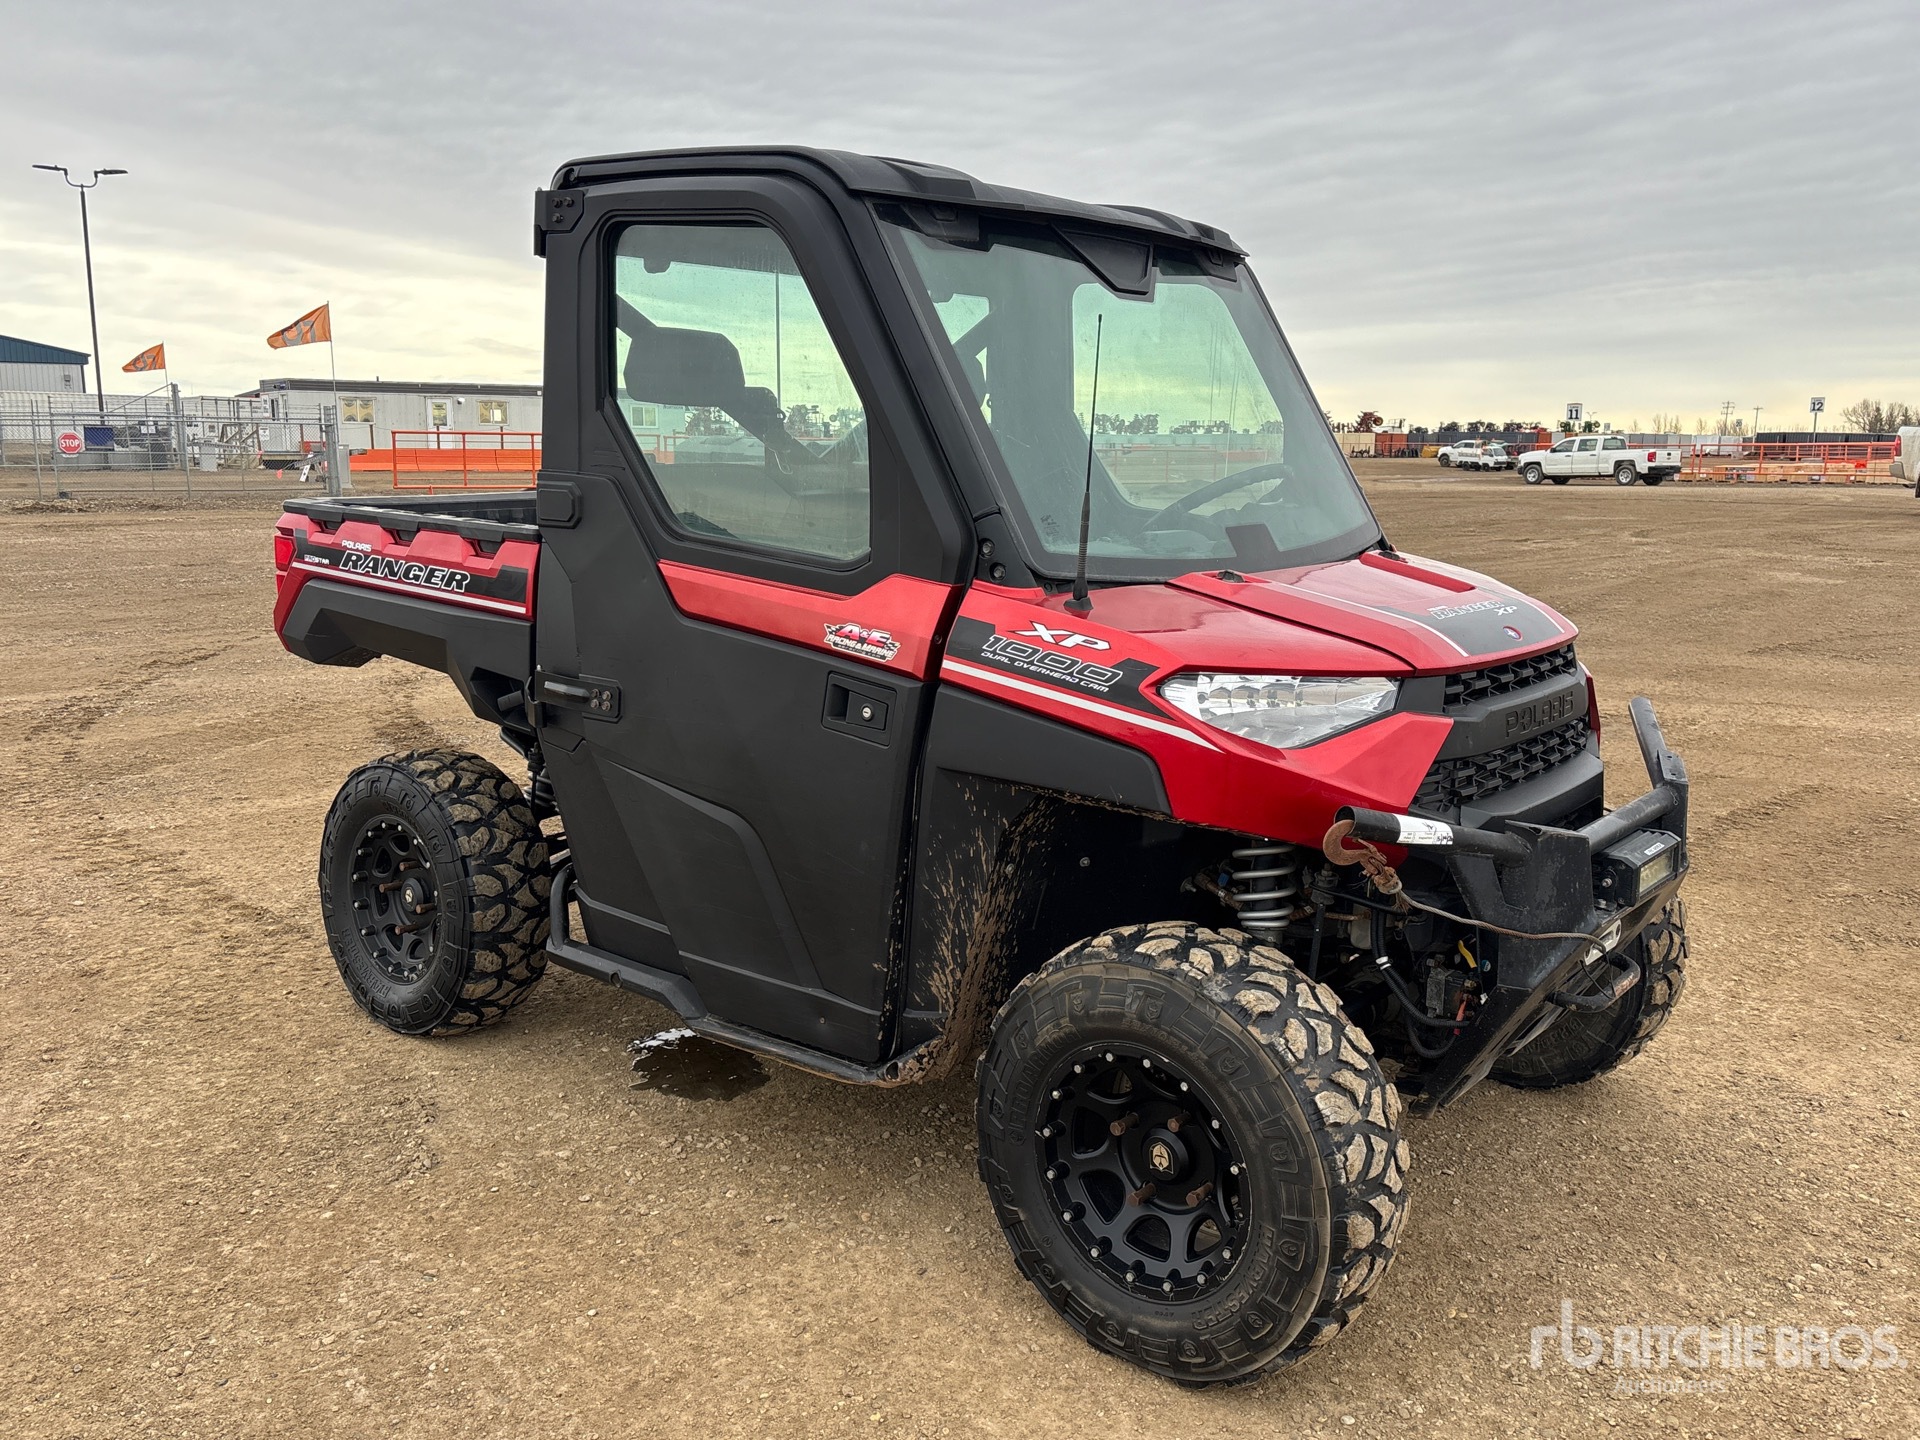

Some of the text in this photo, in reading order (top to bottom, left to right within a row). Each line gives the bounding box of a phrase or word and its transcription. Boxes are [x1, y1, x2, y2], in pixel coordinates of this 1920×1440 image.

[1568, 409, 1580, 420] 11
[1811, 401, 1824, 412] 12
[60, 439, 80, 448] STOP
[341, 539, 372, 552] POLARIS
[339, 550, 471, 593] RANGER
[1493, 605, 1518, 616] XP
[1008, 620, 1112, 651] XP
[981, 634, 1124, 686] 1000
[980, 651, 1109, 693] DUAL OVERHEAD CAM
[1504, 690, 1575, 739] POLARIS
